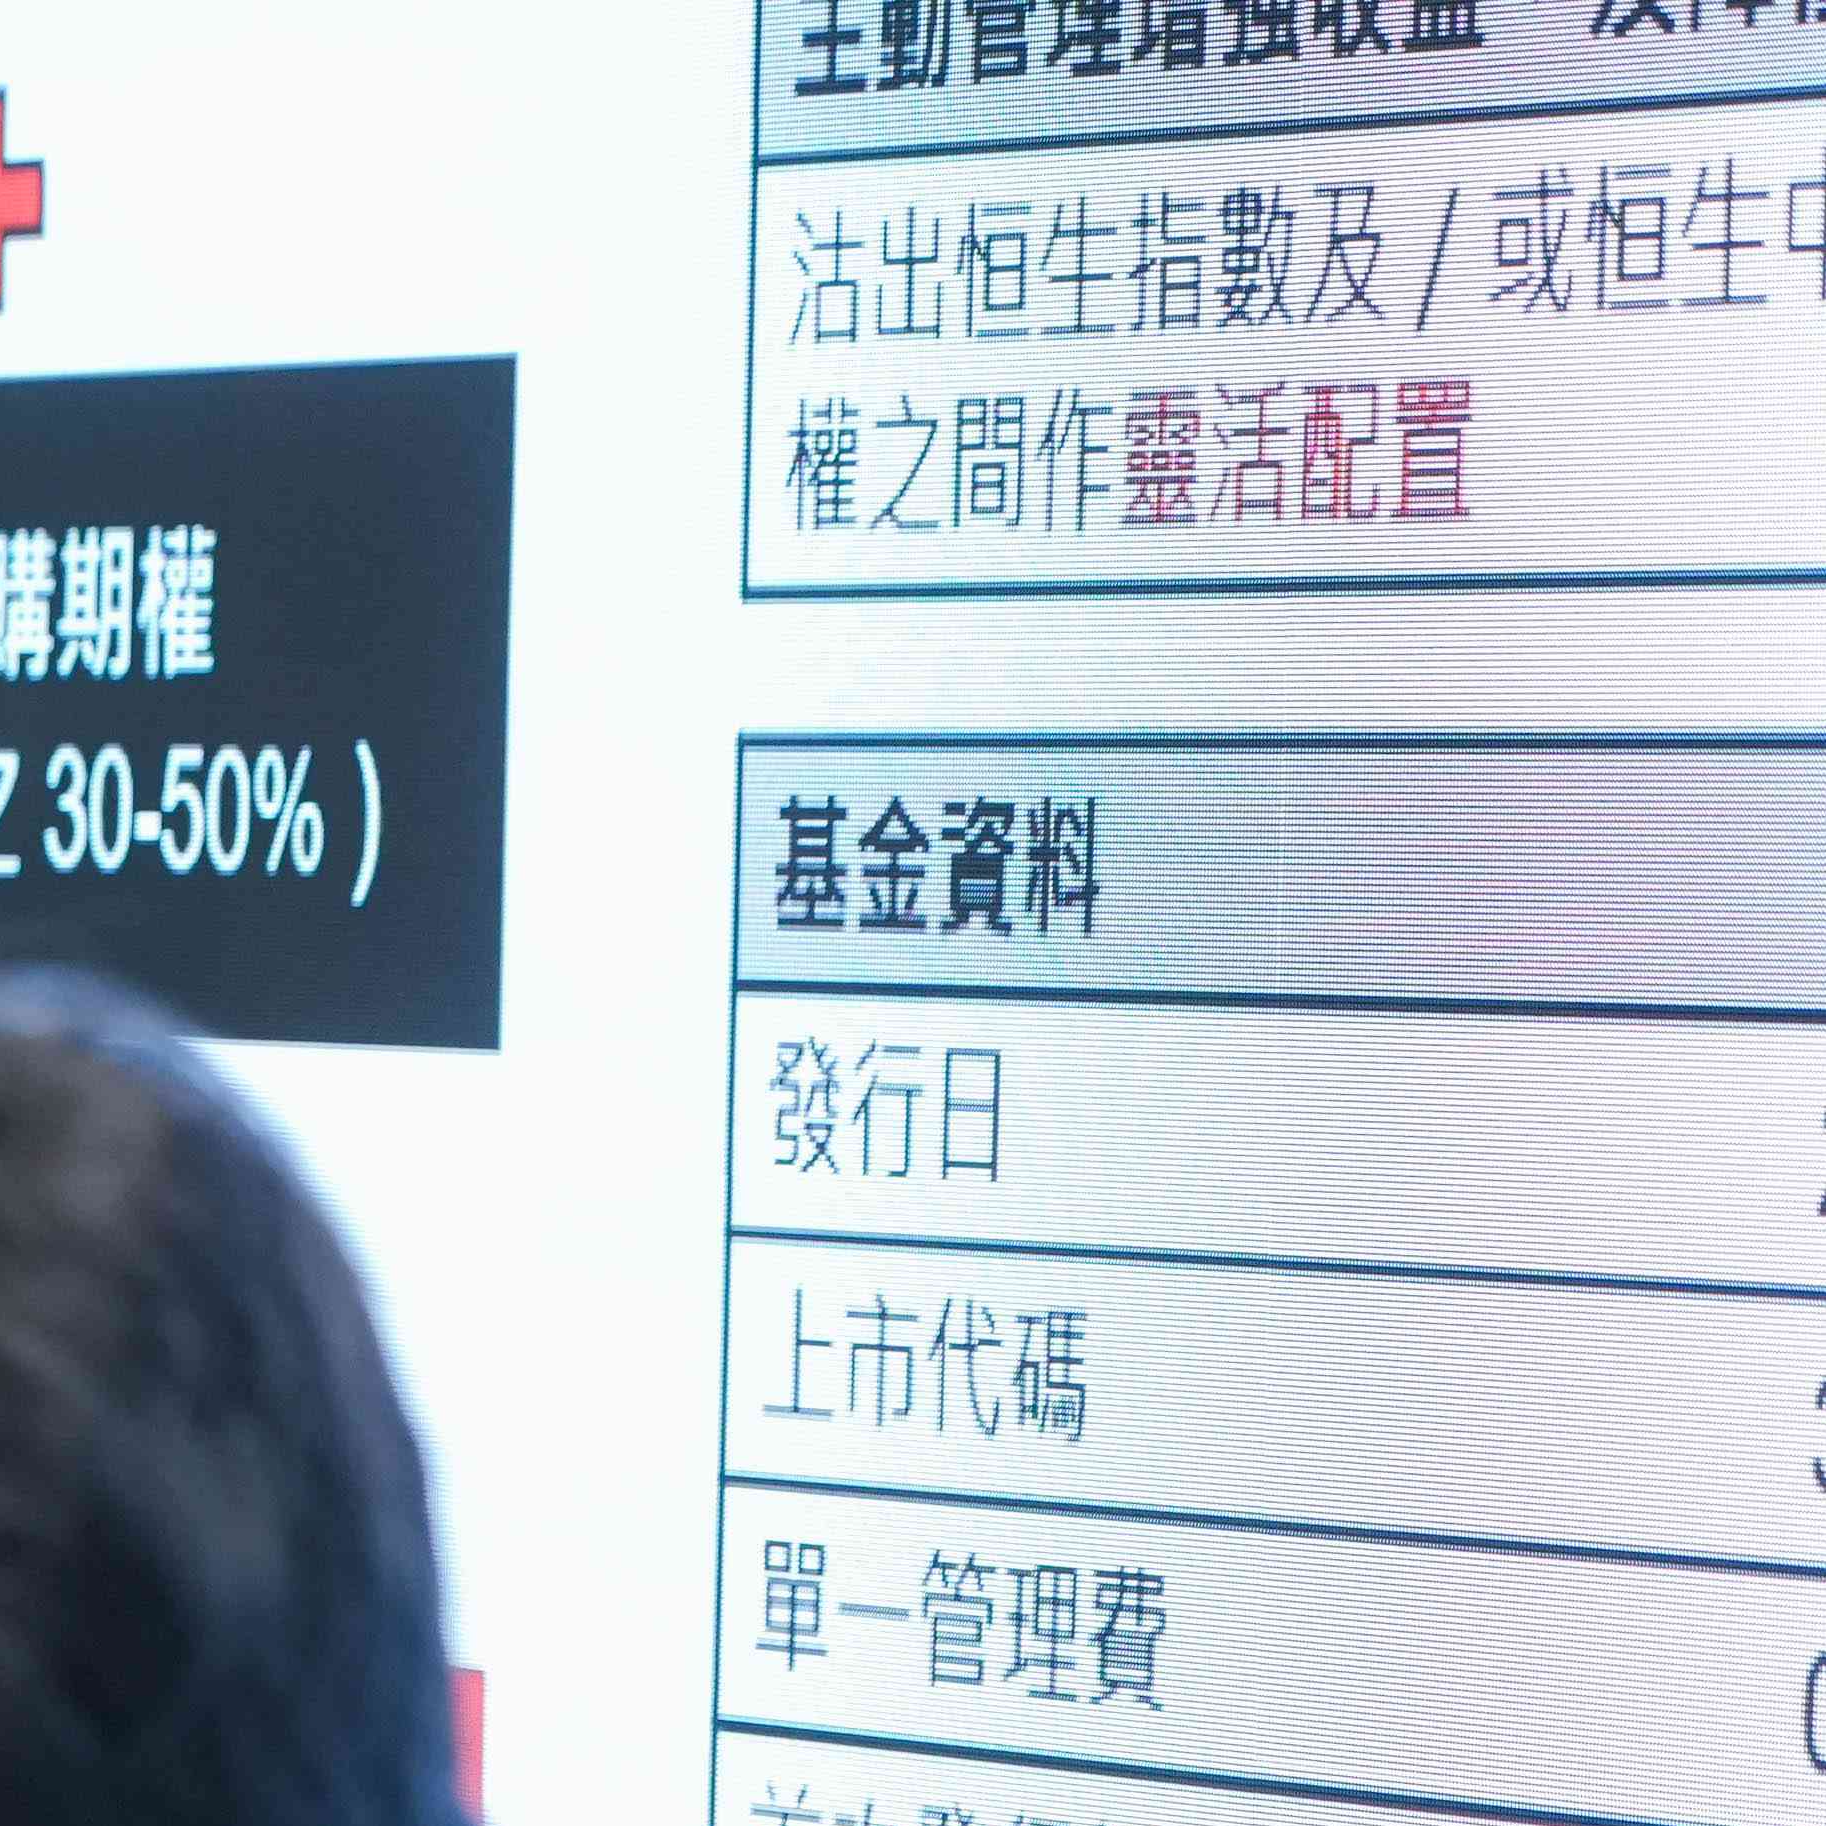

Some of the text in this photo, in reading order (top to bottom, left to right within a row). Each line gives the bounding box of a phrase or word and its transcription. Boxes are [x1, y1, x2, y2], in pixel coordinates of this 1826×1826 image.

[789, 184, 1386, 345] 沽出恒生指數及
[786, 380, 1472, 532] 權之間作靈活配置
[776, 795, 1098, 938] 基金資料
[770, 1036, 1001, 1182] 發行日
[762, 1283, 1087, 1444] 上市代碼
[755, 1539, 1166, 1710] 單一管理費
